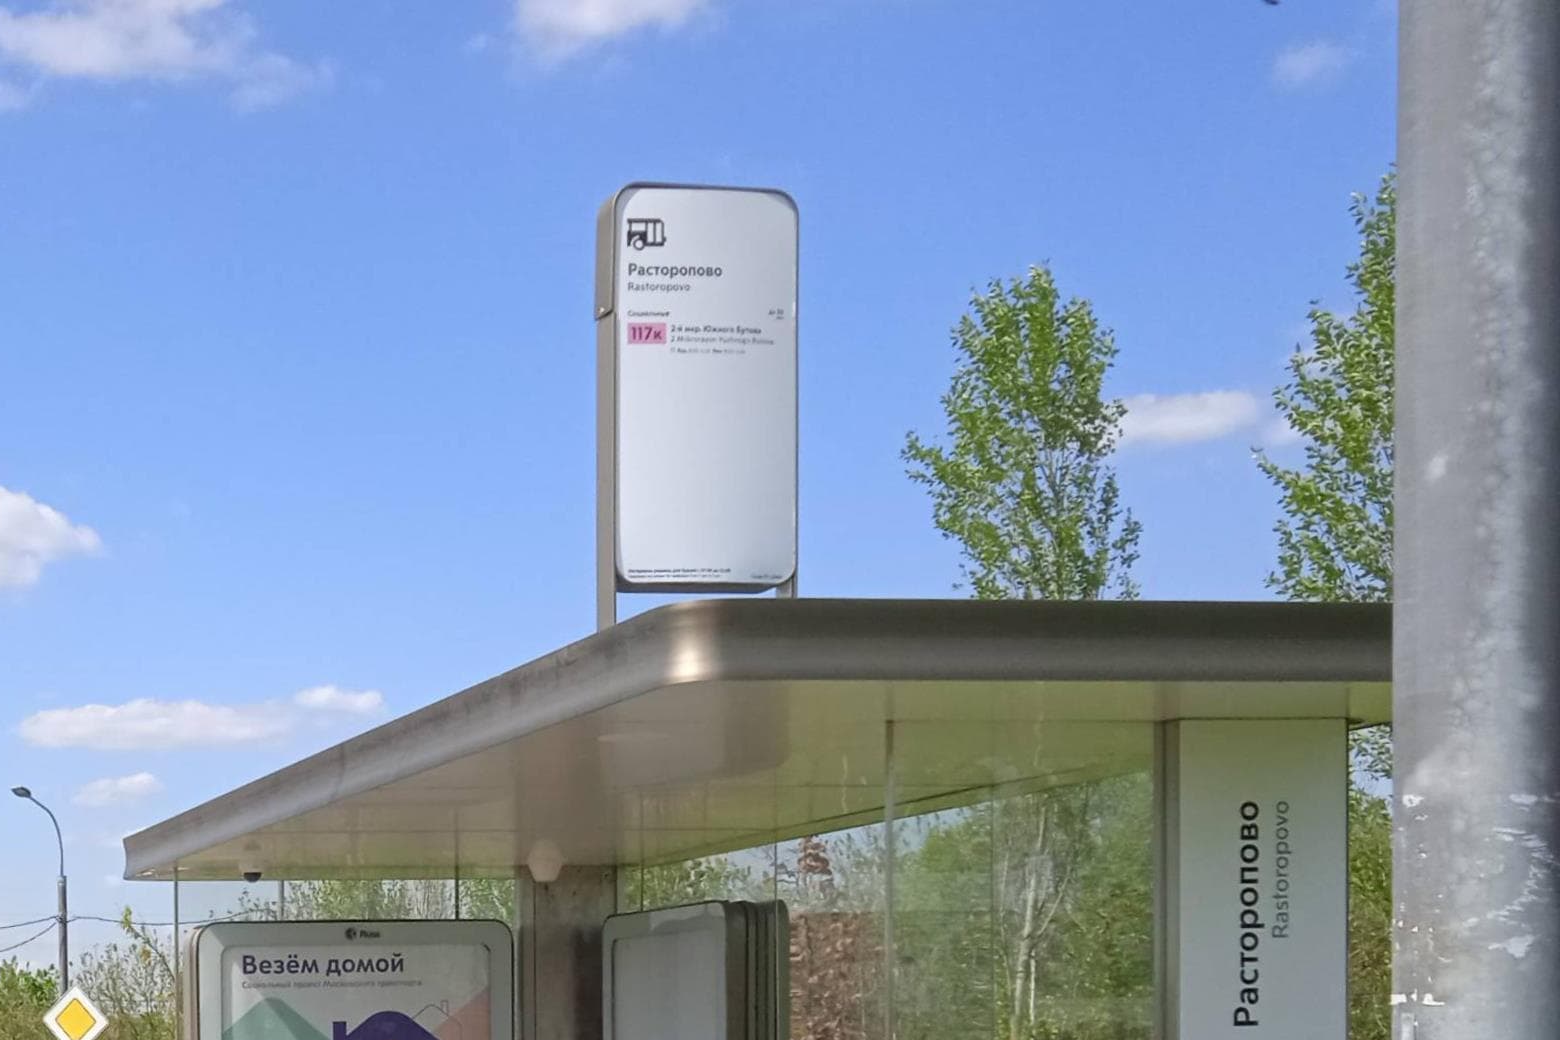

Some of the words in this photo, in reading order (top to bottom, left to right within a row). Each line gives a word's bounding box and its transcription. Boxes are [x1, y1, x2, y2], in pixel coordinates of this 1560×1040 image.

[628, 262, 723, 279] Расторопово
[627, 282, 691, 293] Rastoropovo
[631, 326, 663, 341] 117к
[1272, 801, 1292, 938] Rastoropovo
[1233, 801, 1265, 1026] Расторопово
[242, 954, 320, 975] Везём
[326, 952, 405, 977] домой
